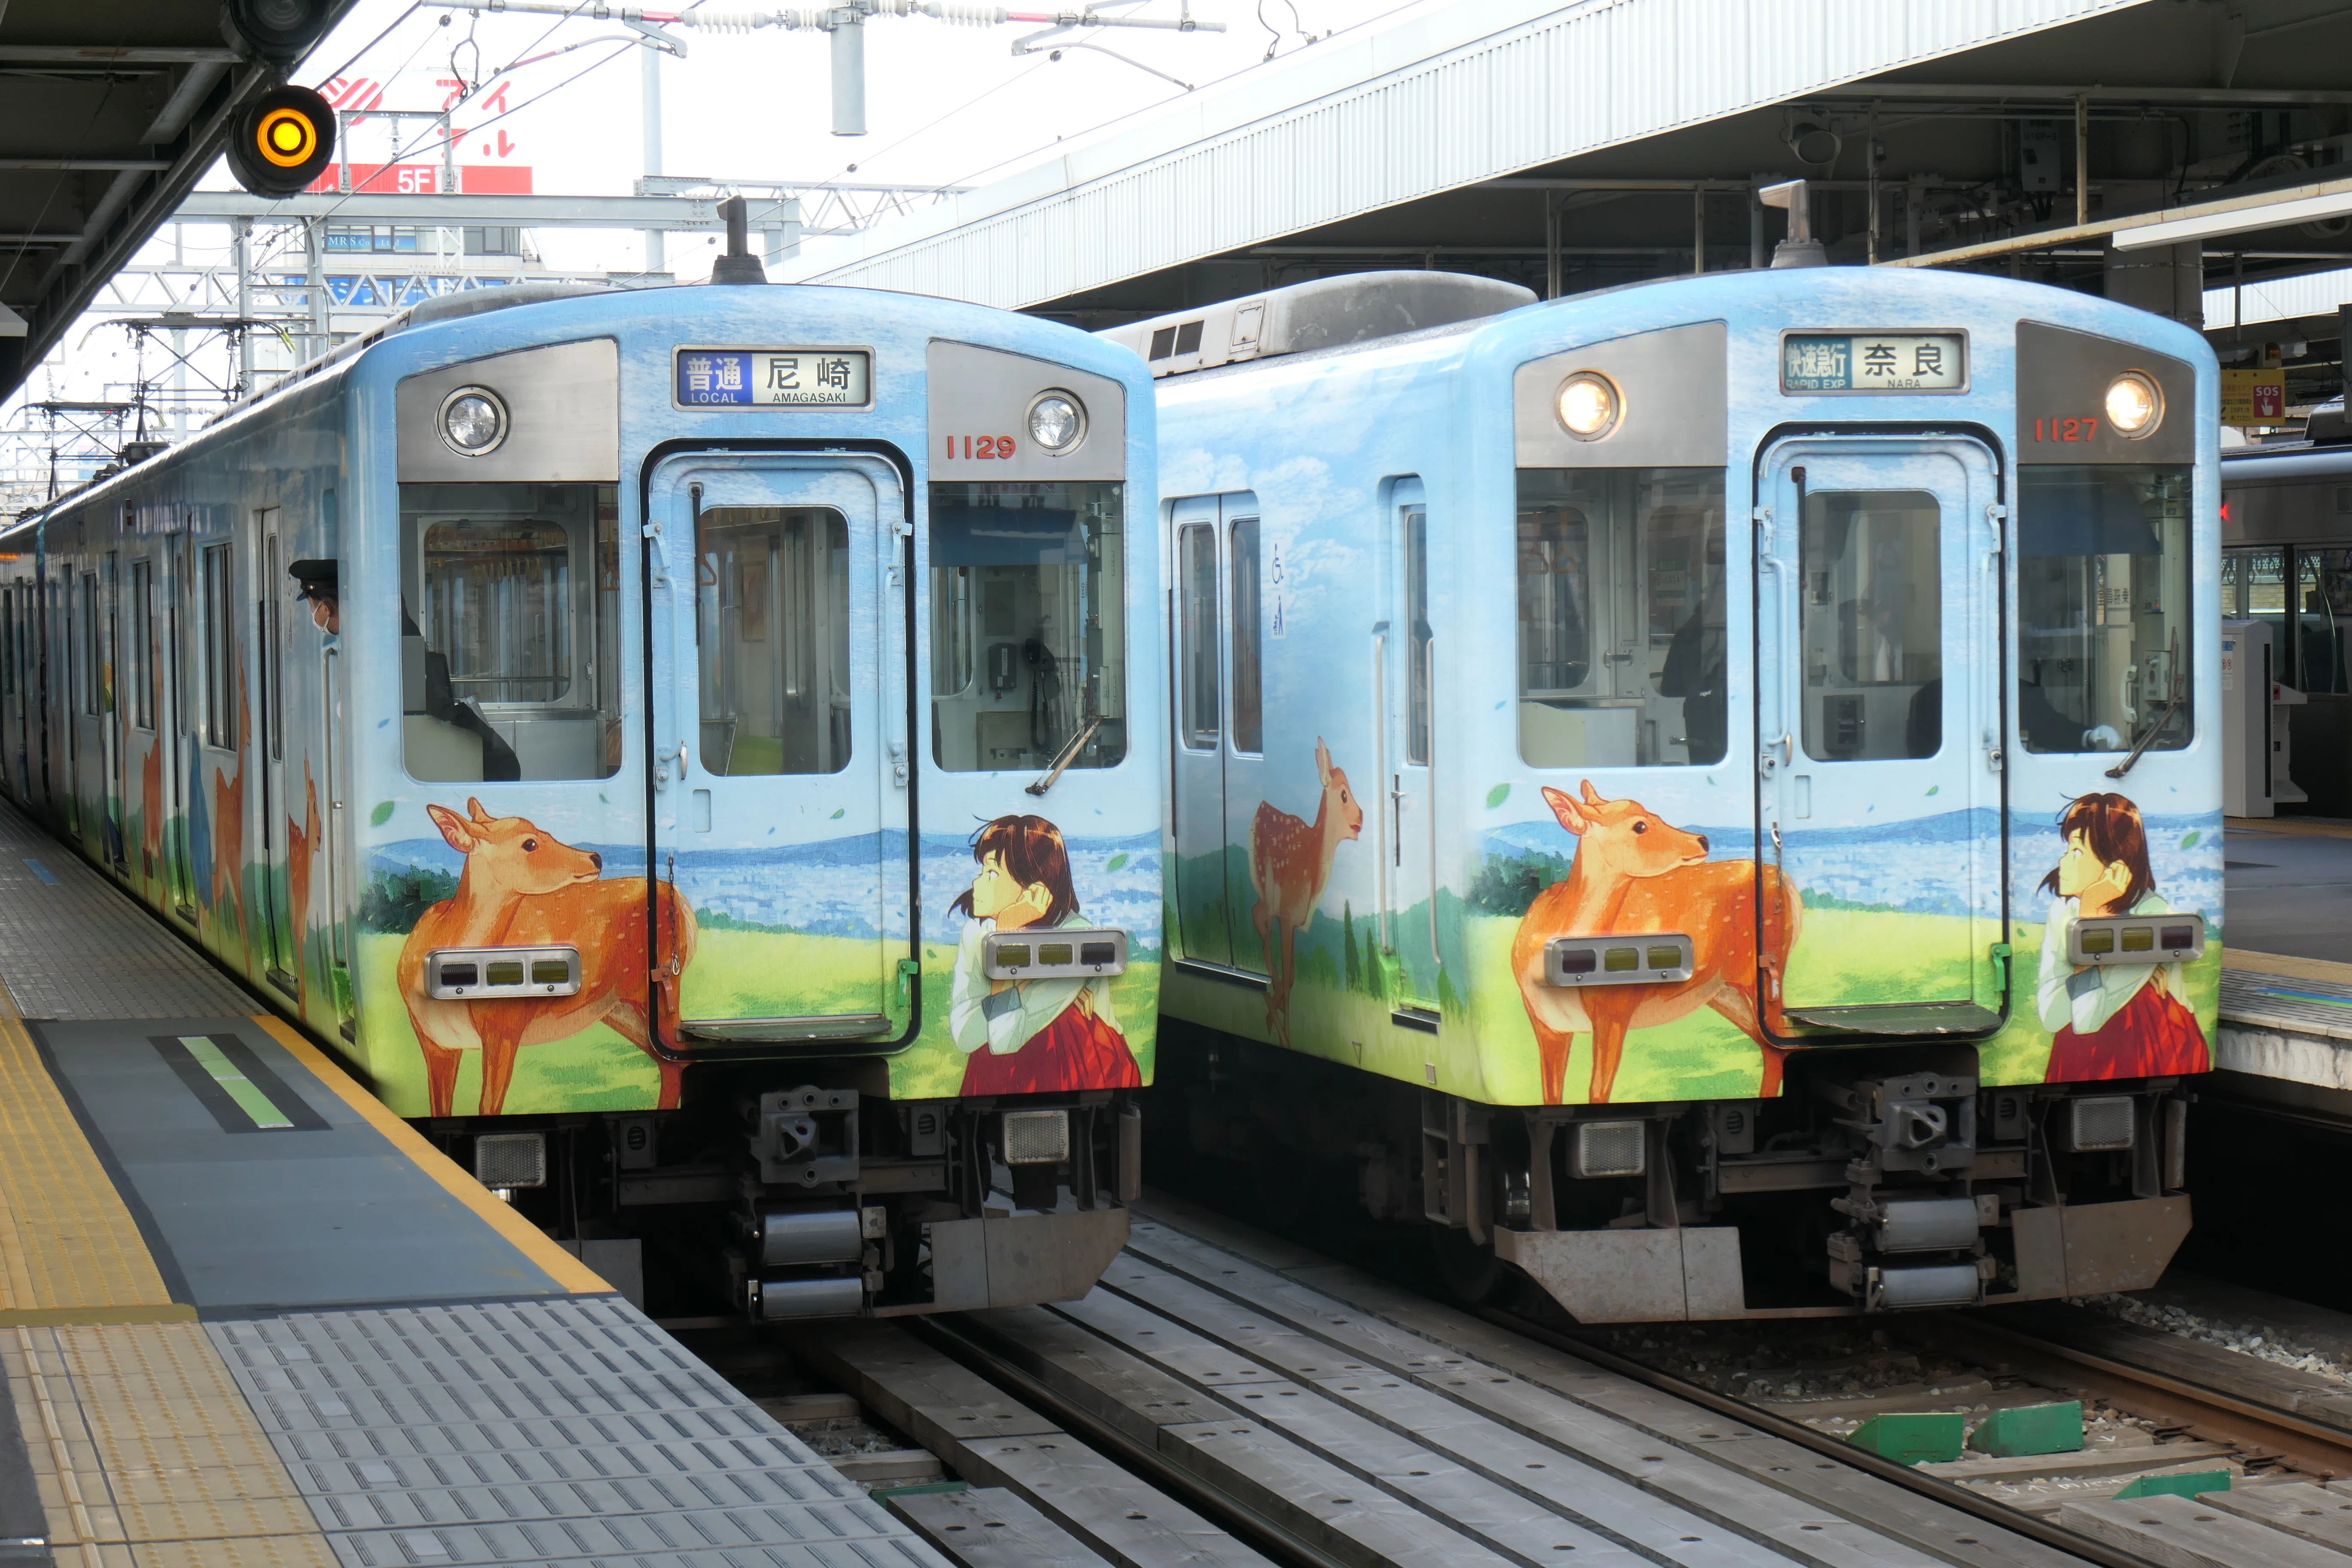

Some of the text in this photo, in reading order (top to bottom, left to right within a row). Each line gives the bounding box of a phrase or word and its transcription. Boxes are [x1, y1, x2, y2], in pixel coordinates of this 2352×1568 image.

[398, 169, 431, 193] 5F
[1785, 343, 1846, 378] 快速急行
[1864, 343, 1944, 377] 奈良
[686, 357, 743, 391] 普通
[767, 357, 851, 391] 尼崎
[1785, 379, 1846, 389] RAPID EXP.
[1888, 379, 1921, 389] NARA
[691, 393, 738, 403] LOCAL
[772, 393, 846, 403] AMAGASAKI
[2256, 386, 2279, 396] SOS
[2035, 417, 2099, 442] 1127
[947, 435, 1017, 459] 1129
